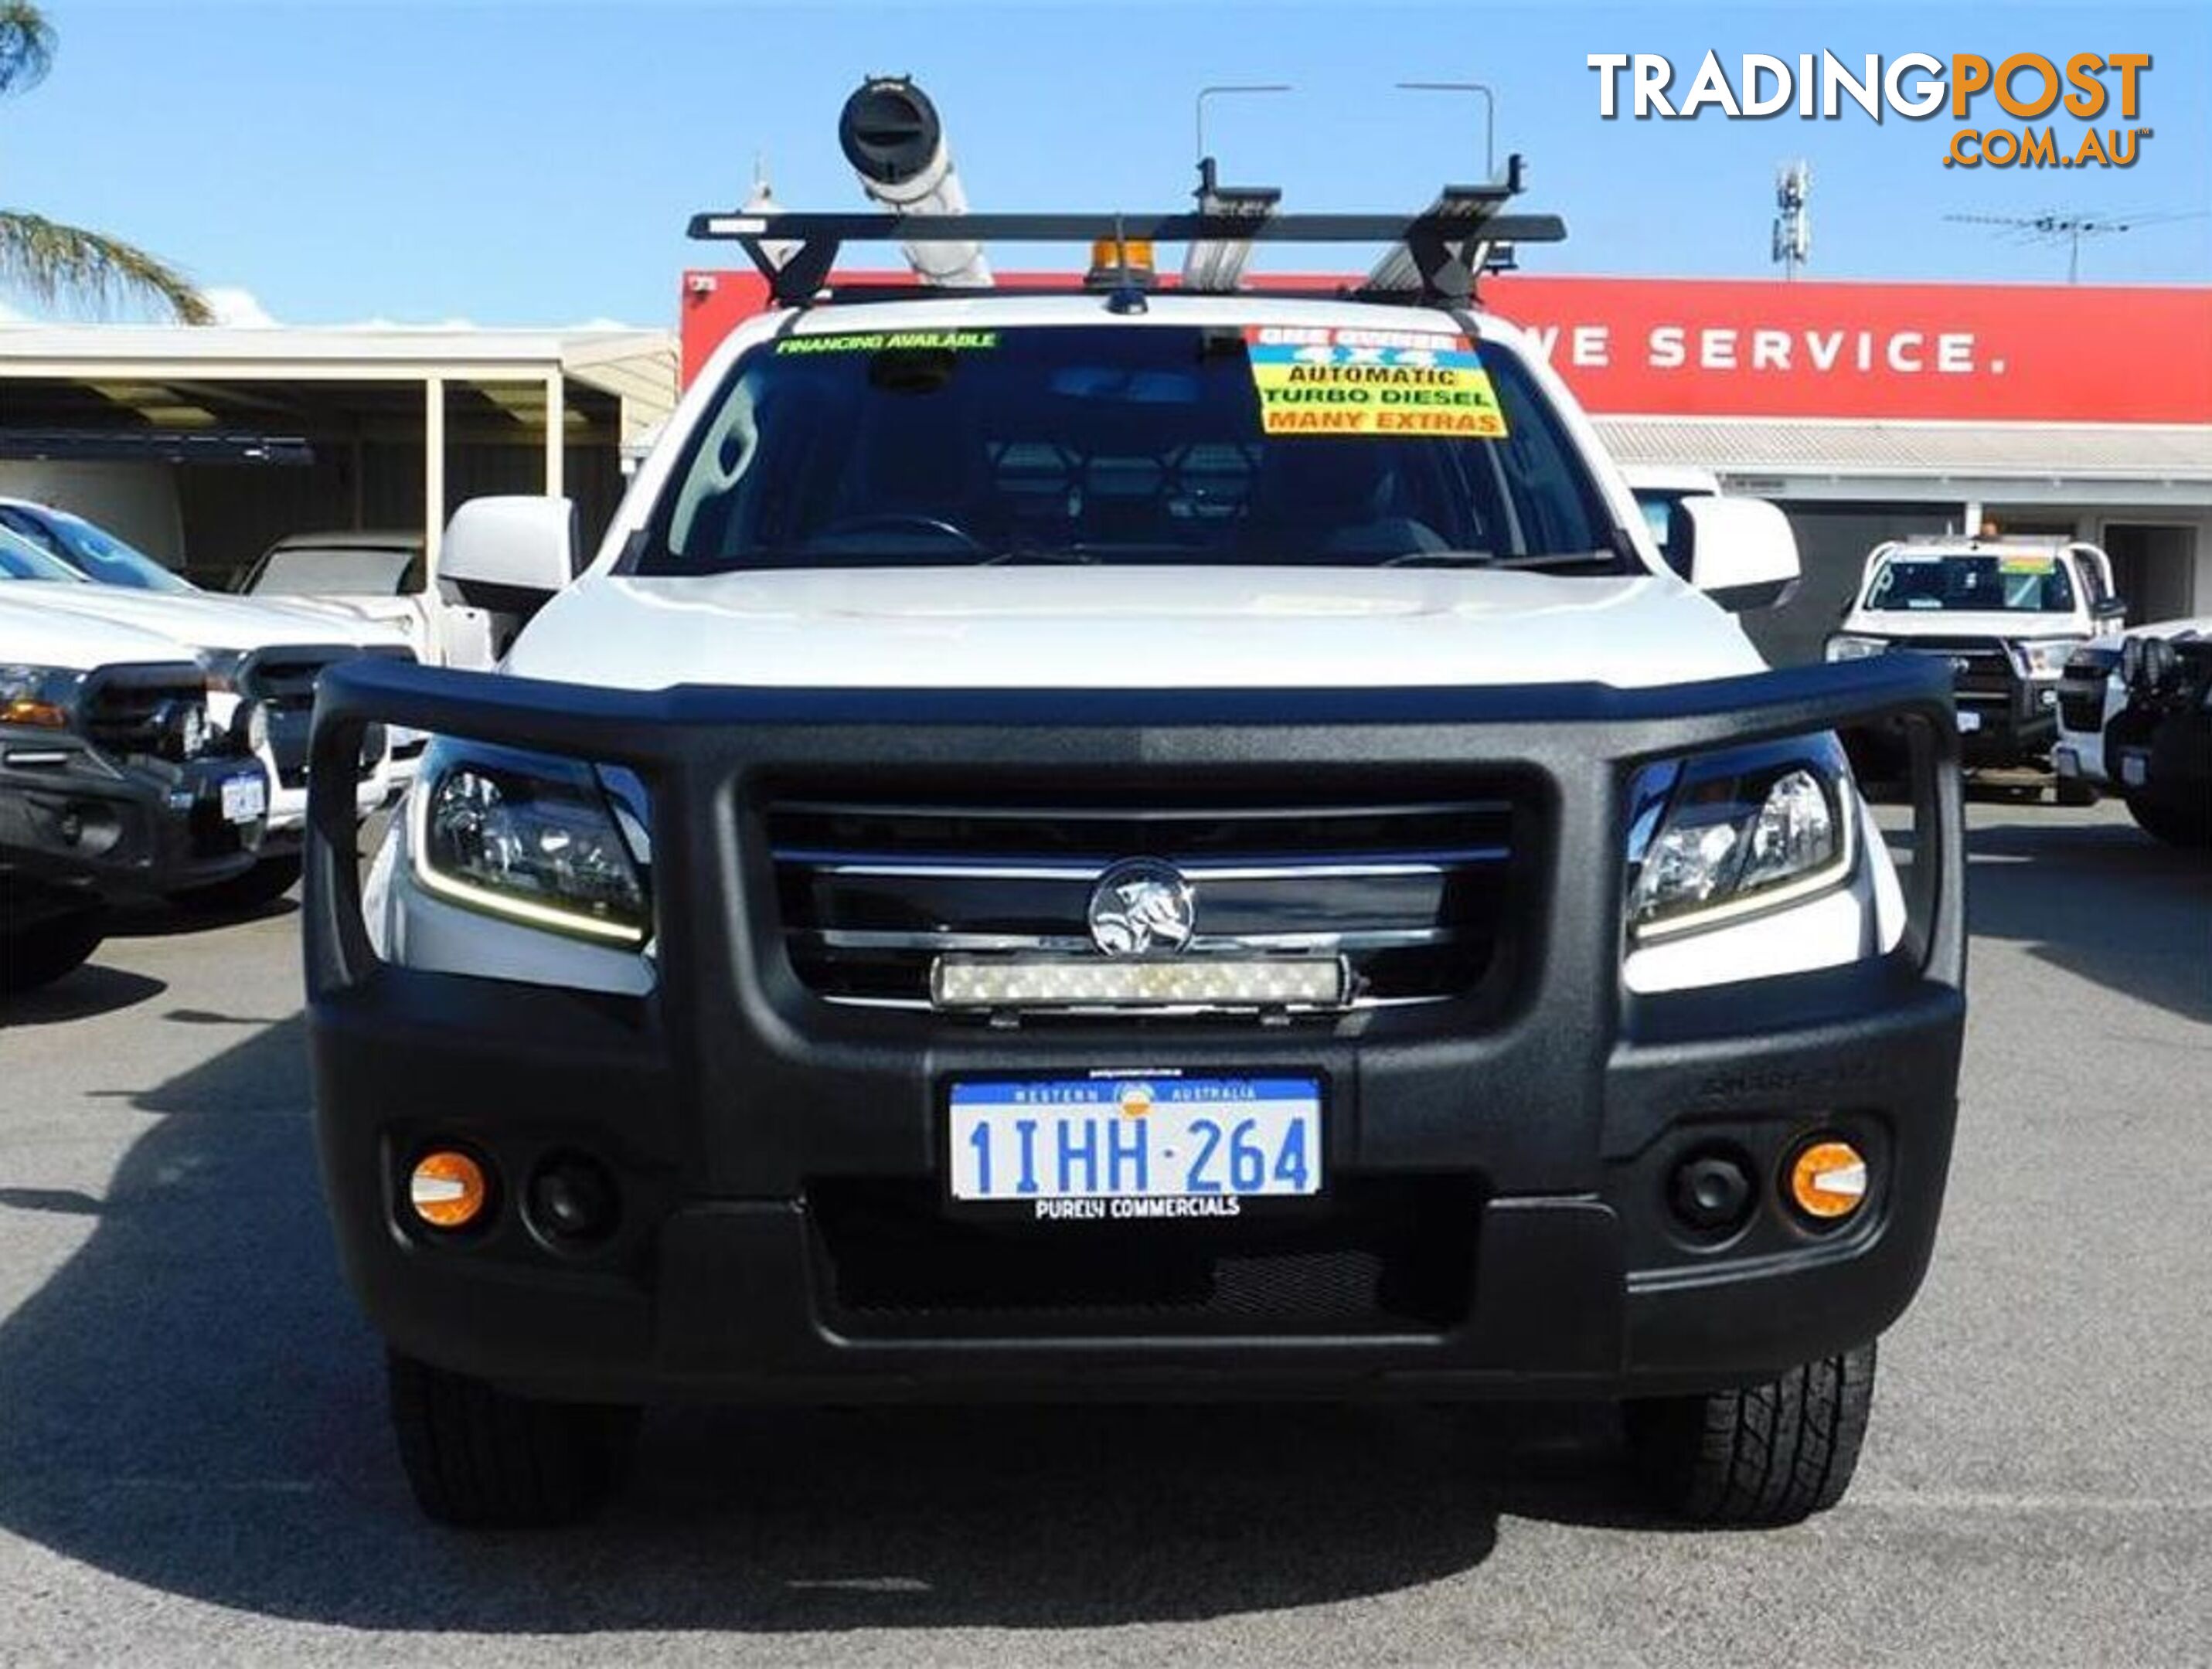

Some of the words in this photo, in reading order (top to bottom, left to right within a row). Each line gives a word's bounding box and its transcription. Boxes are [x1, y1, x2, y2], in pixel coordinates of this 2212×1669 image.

[776, 335, 883, 354] FINANCING
[887, 332, 996, 348] AVAILABLE
[1649, 328, 2006, 372] SERVICE.
[1288, 365, 1458, 386] AUTOMATIC
[1264, 388, 1370, 404] TURBO
[1380, 389, 1491, 407] DIESEL
[1268, 411, 1363, 430] MANY
[1376, 413, 1499, 433] EXTRAS
[1016, 1089, 1098, 1102] WESTERN
[1172, 1086, 1256, 1101] AUSTRALIA
[1036, 1200, 1106, 1219] PURELY
[1111, 1197, 1240, 1218] COMMERCIALS
